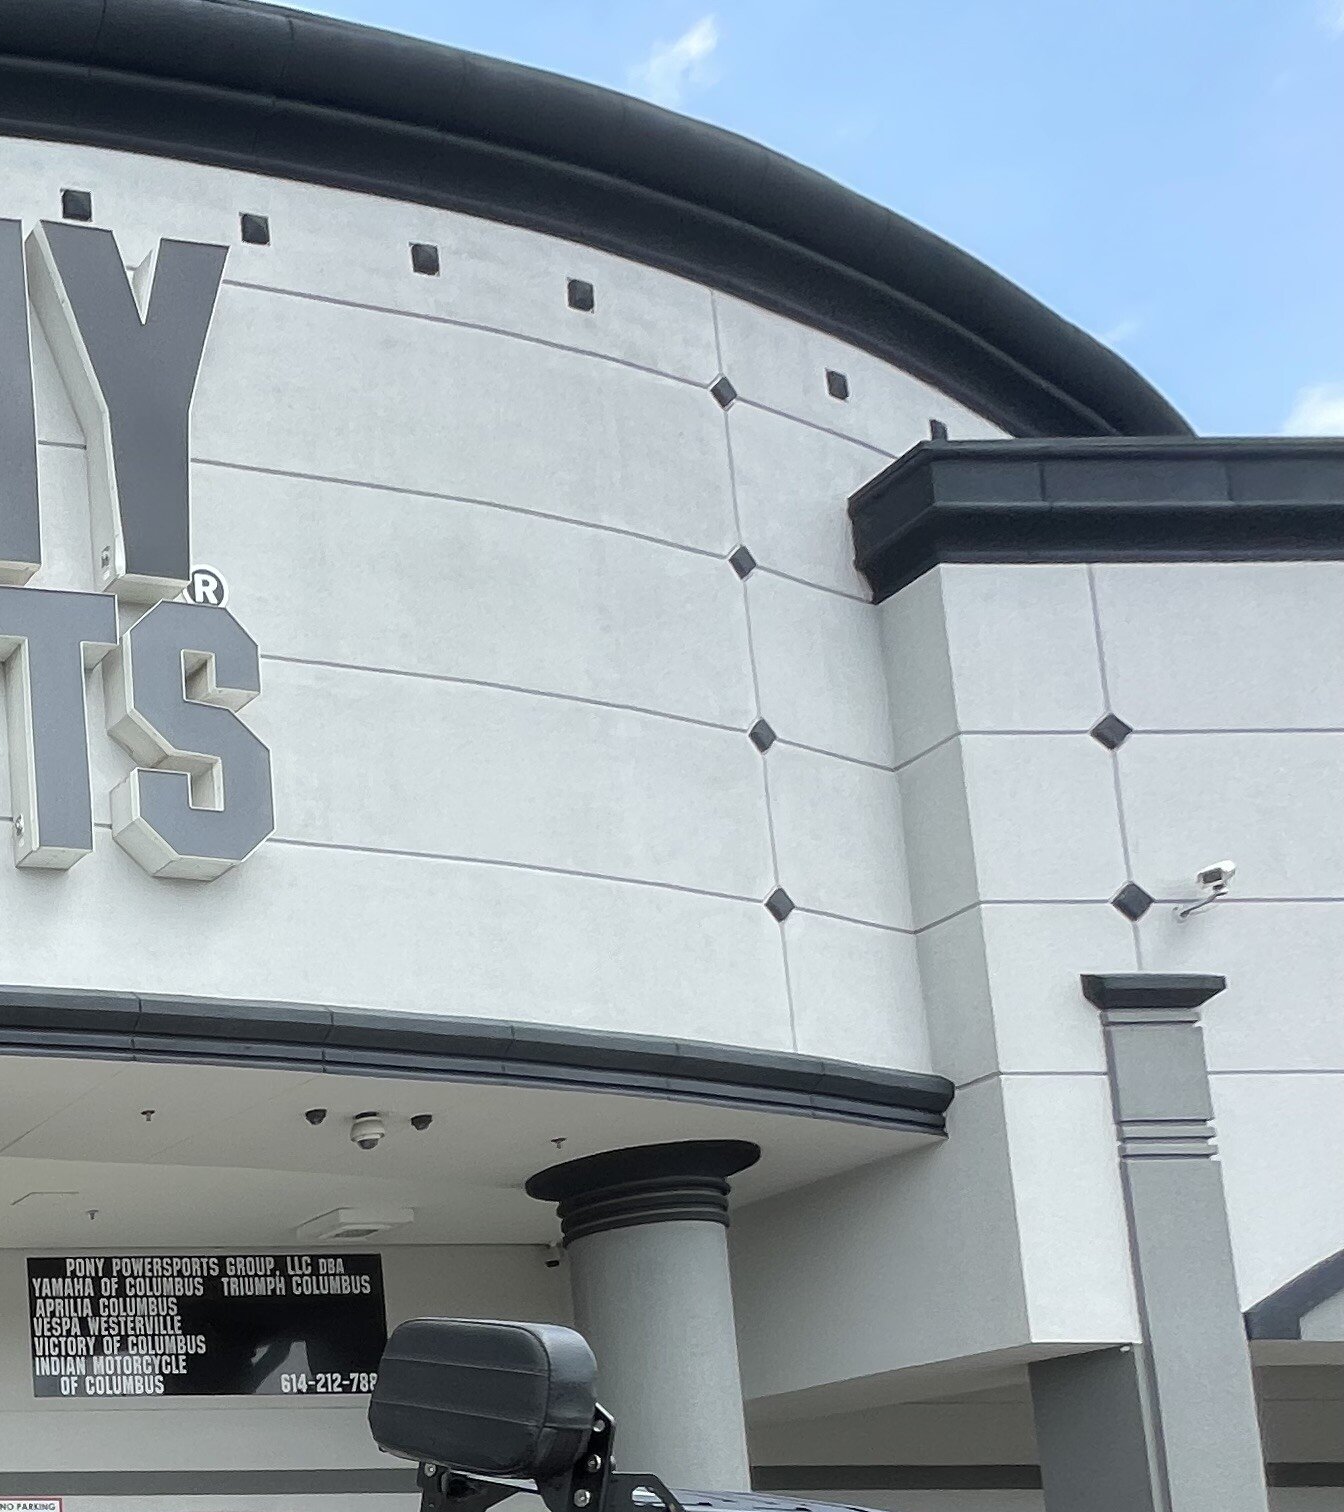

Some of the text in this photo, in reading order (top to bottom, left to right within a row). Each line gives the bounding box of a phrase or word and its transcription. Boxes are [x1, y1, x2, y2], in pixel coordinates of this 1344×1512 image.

[65, 1258, 105, 1277] PONY
[112, 1257, 219, 1277] POWERSPORTS
[286, 1256, 312, 1275] LLC
[318, 1258, 345, 1274] DBA
[32, 1277, 204, 1297] YAMAHA OF COLUMBUS
[221, 1275, 371, 1296] TRIUMPH COLUMBUS
[35, 1297, 178, 1318] APRILIA COLUMBUS
[33, 1315, 183, 1336] VESPA WESTERVILLE
[34, 1335, 206, 1356] VICTORY OF COLUMBUS
[35, 1355, 188, 1376] INDIAN MOTORCYCLE
[61, 1375, 165, 1395] OF COLUMBUS
